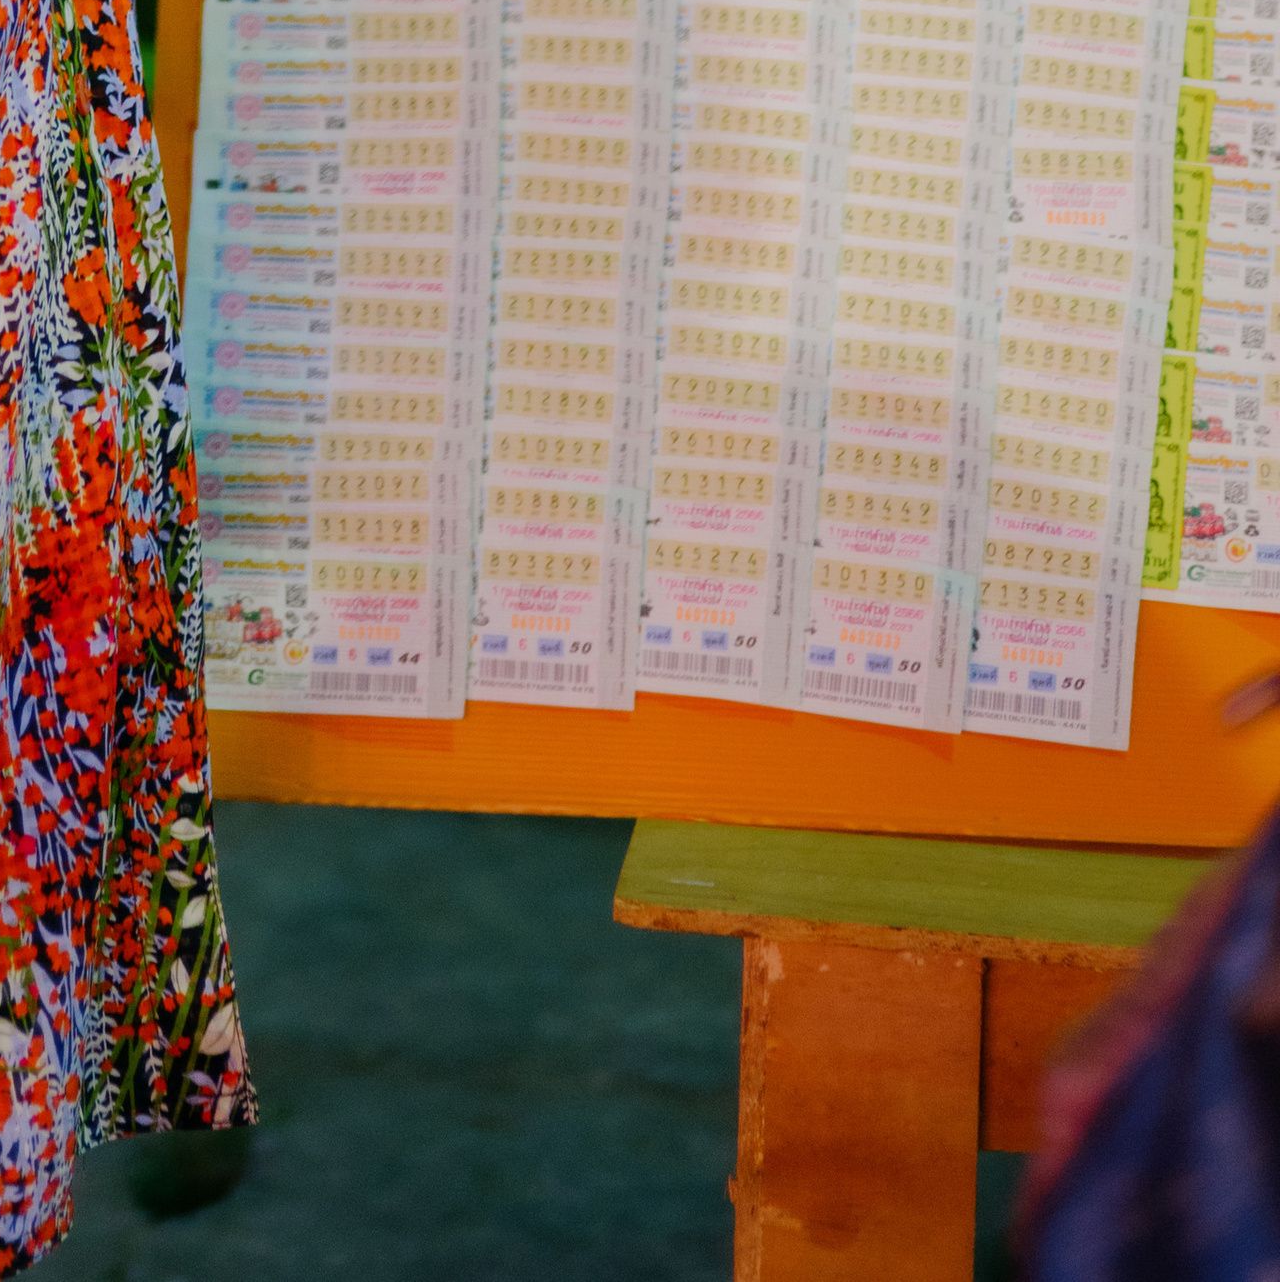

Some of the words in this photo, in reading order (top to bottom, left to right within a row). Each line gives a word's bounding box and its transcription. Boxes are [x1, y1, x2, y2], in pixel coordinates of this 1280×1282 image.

[699, 8, 800, 29] 983663
[864, 13, 968, 36] 413738
[1034, 7, 1138, 34] 520012
[862, 46, 965, 70] 587839
[1030, 59, 1133, 87] 308313
[525, 84, 626, 103] 836289
[857, 87, 962, 110] 835740
[701, 106, 803, 132] 028165
[1022, 102, 1127, 128] 984114
[523, 135, 625, 157] 915890
[851, 128, 953, 155] 916241
[692, 145, 795, 168] 655766
[1019, 151, 1125, 171] 488216
[521, 178, 621, 201] 253591
[851, 170, 956, 197] 075942
[691, 189, 794, 213] 903667
[513, 215, 617, 236] 099692
[842, 207, 947, 235] 475243
[511, 251, 612, 270] 723593
[685, 237, 788, 262] 848468
[841, 248, 946, 275] 071644
[1021, 239, 1125, 269] 392817
[506, 295, 609, 316] 217994
[677, 282, 782, 306] 600469
[1013, 290, 1117, 319] 903218
[340, 301, 441, 321] 930493
[844, 295, 948, 324] 971045
[504, 342, 608, 364] 275195
[676, 328, 780, 354] 543070
[338, 348, 438, 367] 055794
[841, 341, 946, 367] 150446
[1004, 340, 1111, 369] 848819
[503, 387, 607, 411] 112896
[668, 376, 771, 400] 790971
[335, 395, 437, 415] 045795
[837, 391, 943, 416] 533047
[1001, 387, 1108, 420] 216220
[327, 439, 426, 457] 395096
[498, 436, 603, 457] 610997
[667, 430, 772, 455] 961072
[995, 437, 1100, 470] 542621
[833, 446, 940, 473] 286348
[319, 475, 422, 491] 722097
[660, 471, 766, 493] 713173
[494, 490, 597, 512] 858898
[824, 492, 932, 518] 858449
[992, 482, 1099, 514] 790522
[321, 517, 422, 534] 312198
[1066, 526, 1098, 542] 2566
[488, 551, 593, 573] 893299
[652, 543, 759, 567] 465274
[984, 541, 1092, 571] 087923
[316, 565, 420, 583] 600799
[820, 562, 927, 592] 101350
[979, 581, 1087, 609] 713524
[682, 630, 692, 643] 6
[734, 635, 758, 649] 50
[840, 626, 901, 651] 0602033
[1055, 624, 1088, 638] 2566
[348, 648, 357, 662] 6
[398, 652, 421, 665] 44
[519, 638, 527, 651] 6
[568, 641, 593, 654] 50
[1002, 644, 1065, 668] 0602033
[846, 652, 856, 666] 6
[897, 659, 922, 674] 50
[1008, 670, 1018, 684] 6
[1061, 676, 1086, 691] 50
